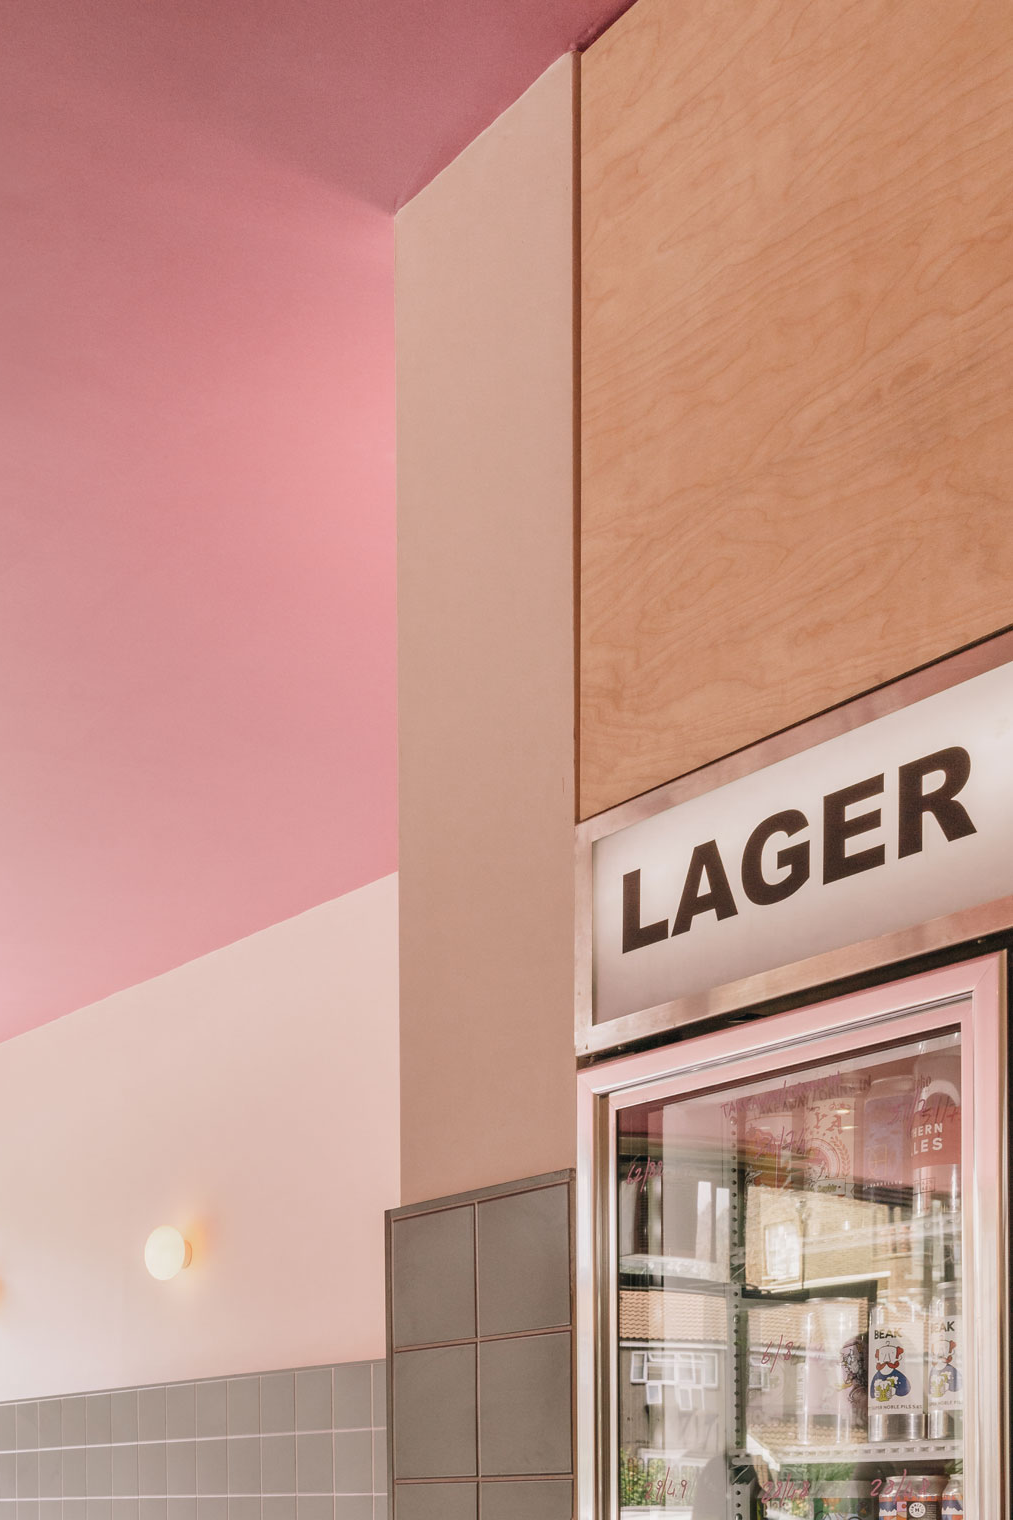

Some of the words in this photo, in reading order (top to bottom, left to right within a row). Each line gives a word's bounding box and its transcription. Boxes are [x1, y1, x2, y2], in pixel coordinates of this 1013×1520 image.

[622, 746, 977, 954] LAGER
[911, 1137, 943, 1157] LES
[874, 1327, 904, 1340] BEAK
